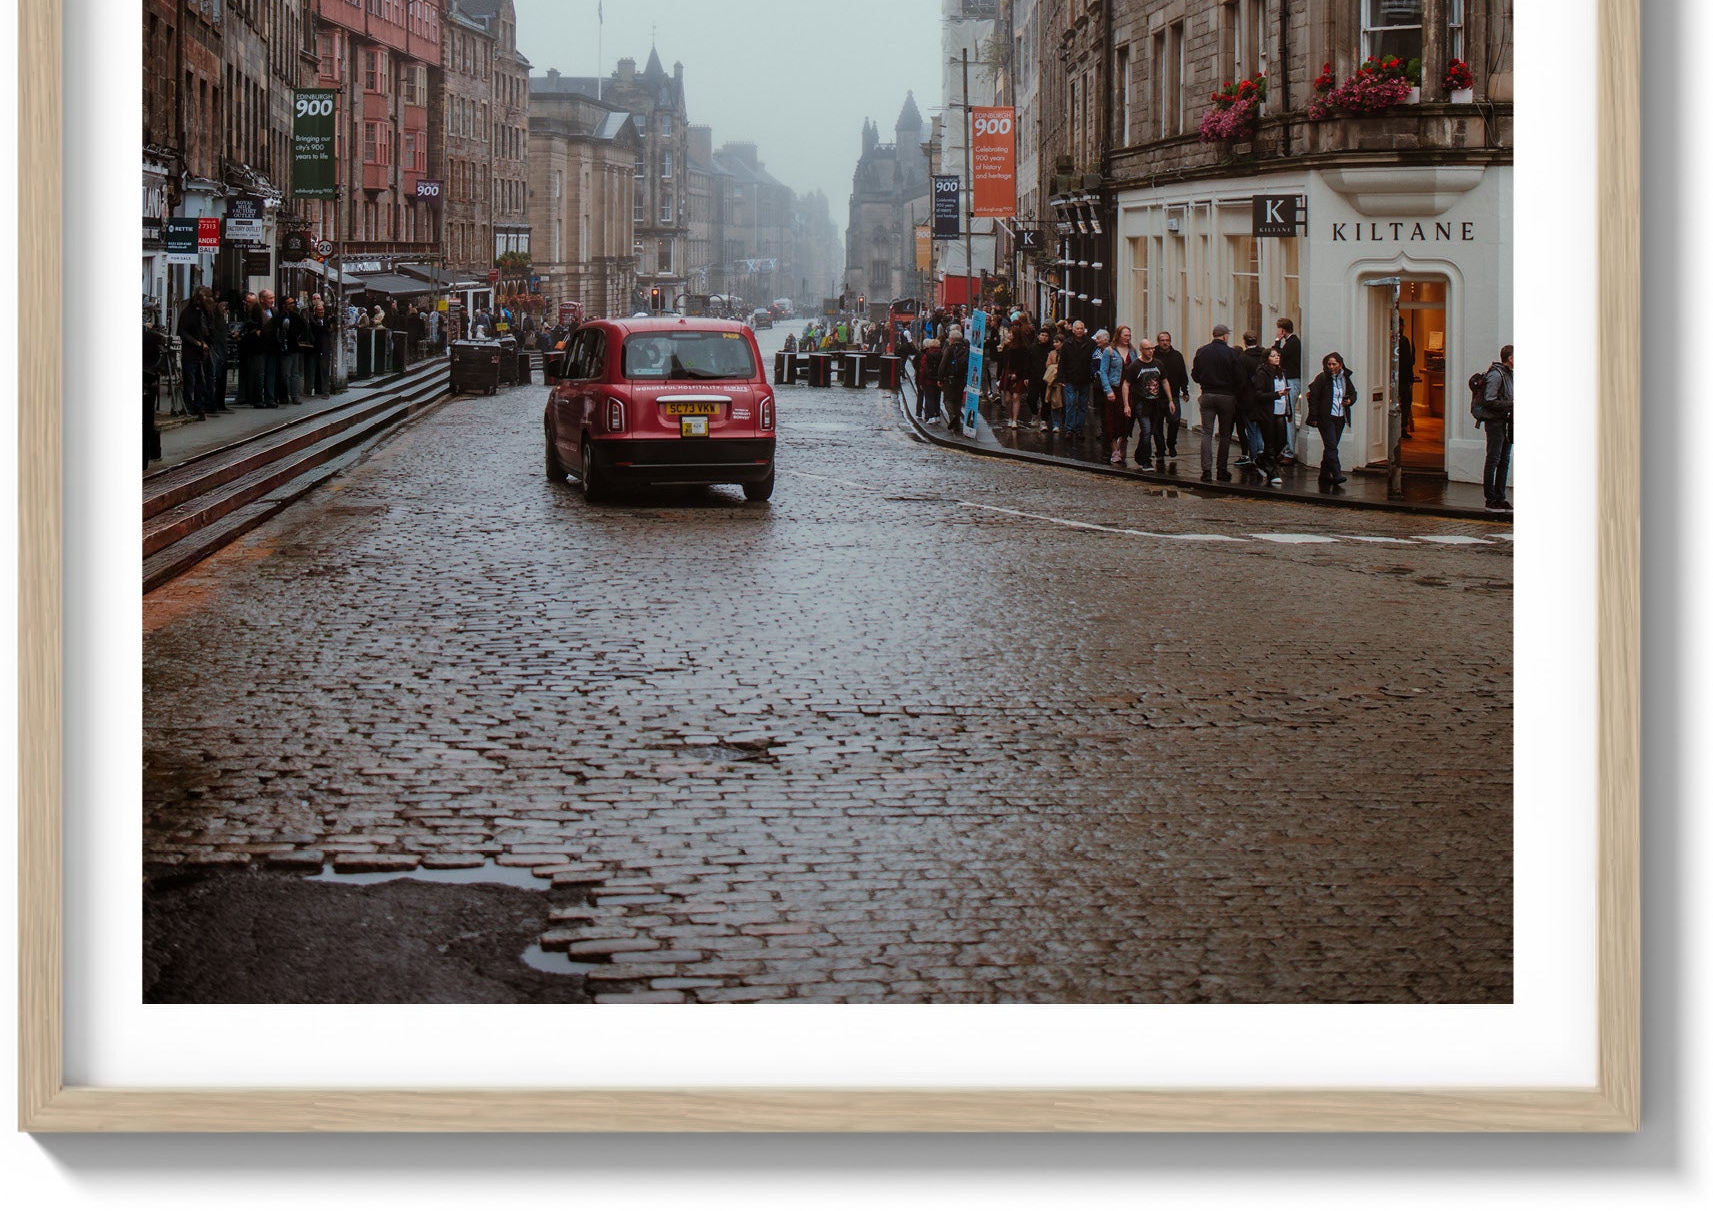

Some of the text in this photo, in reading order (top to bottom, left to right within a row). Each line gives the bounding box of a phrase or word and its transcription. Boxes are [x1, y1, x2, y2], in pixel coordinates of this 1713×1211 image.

[296, 100, 332, 118] 900
[974, 118, 1011, 136] 900
[296, 135, 320, 143] Bringing
[296, 144, 310, 152] city's
[417, 186, 439, 197] 900
[936, 182, 958, 192] 900
[1266, 200, 1284, 223] K
[1332, 222, 1474, 241] KILTANE
[1024, 232, 1034, 244] K
[670, 403, 695, 413] SC73
